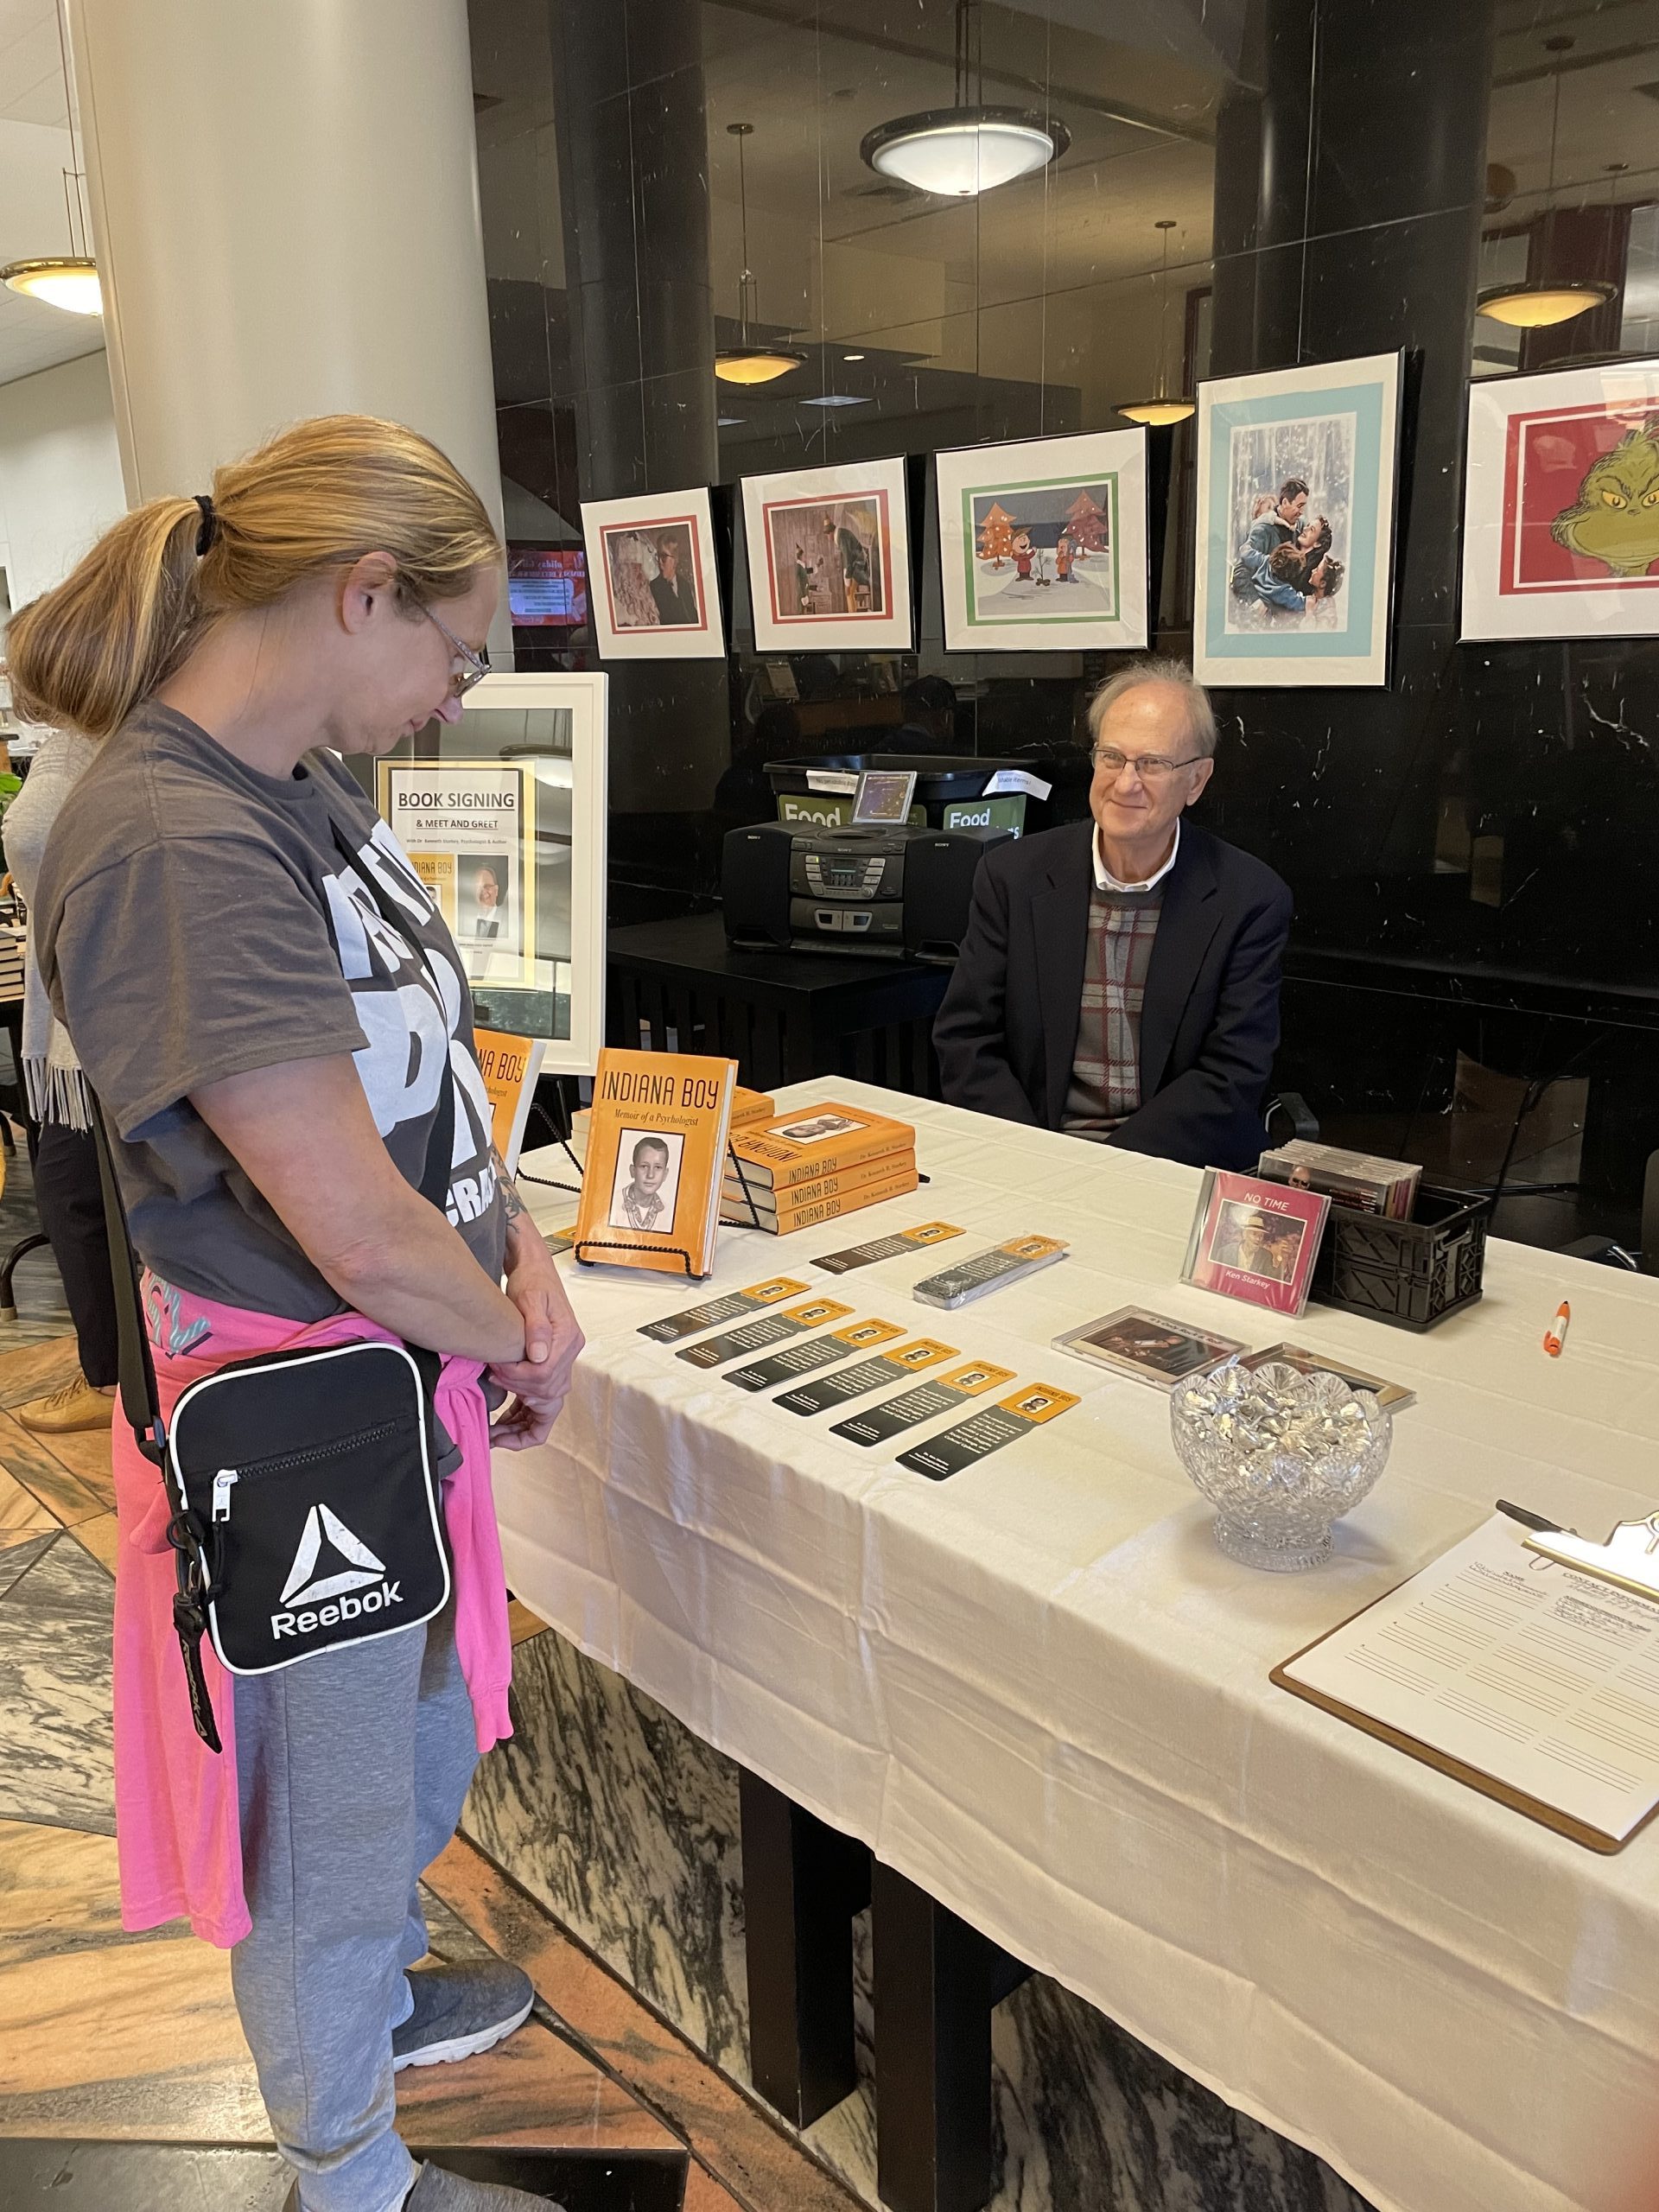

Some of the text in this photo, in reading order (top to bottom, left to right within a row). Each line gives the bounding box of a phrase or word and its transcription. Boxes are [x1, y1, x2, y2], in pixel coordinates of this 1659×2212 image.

[398, 792, 515, 808] BOOK SIGNING
[416, 819, 423, 828] &
[425, 819, 448, 828] MEET
[472, 820, 499, 829] GREET
[785, 803, 842, 829] Food
[950, 808, 991, 829] Food
[437, 861, 452, 874] BOY
[497, 1052, 527, 1084] BOY
[601, 1071, 720, 1110] INDIANA BOY
[614, 1108, 639, 1121] Memoir
[640, 1110, 650, 1123] of
[655, 1112, 699, 1128] Psychologist
[788, 1162, 820, 1185] INDIANA
[822, 1157, 837, 1174] BOY
[791, 1181, 822, 1206] INDIANA
[823, 1177, 839, 1196] BOY
[1244, 1192, 1290, 1211] NO TIME
[793, 1202, 824, 1228] INDIANA
[826, 1198, 842, 1217] BOY
[1225, 1269, 1271, 1290] Ken Starkey
[270, 1580, 404, 1640] Reebok
